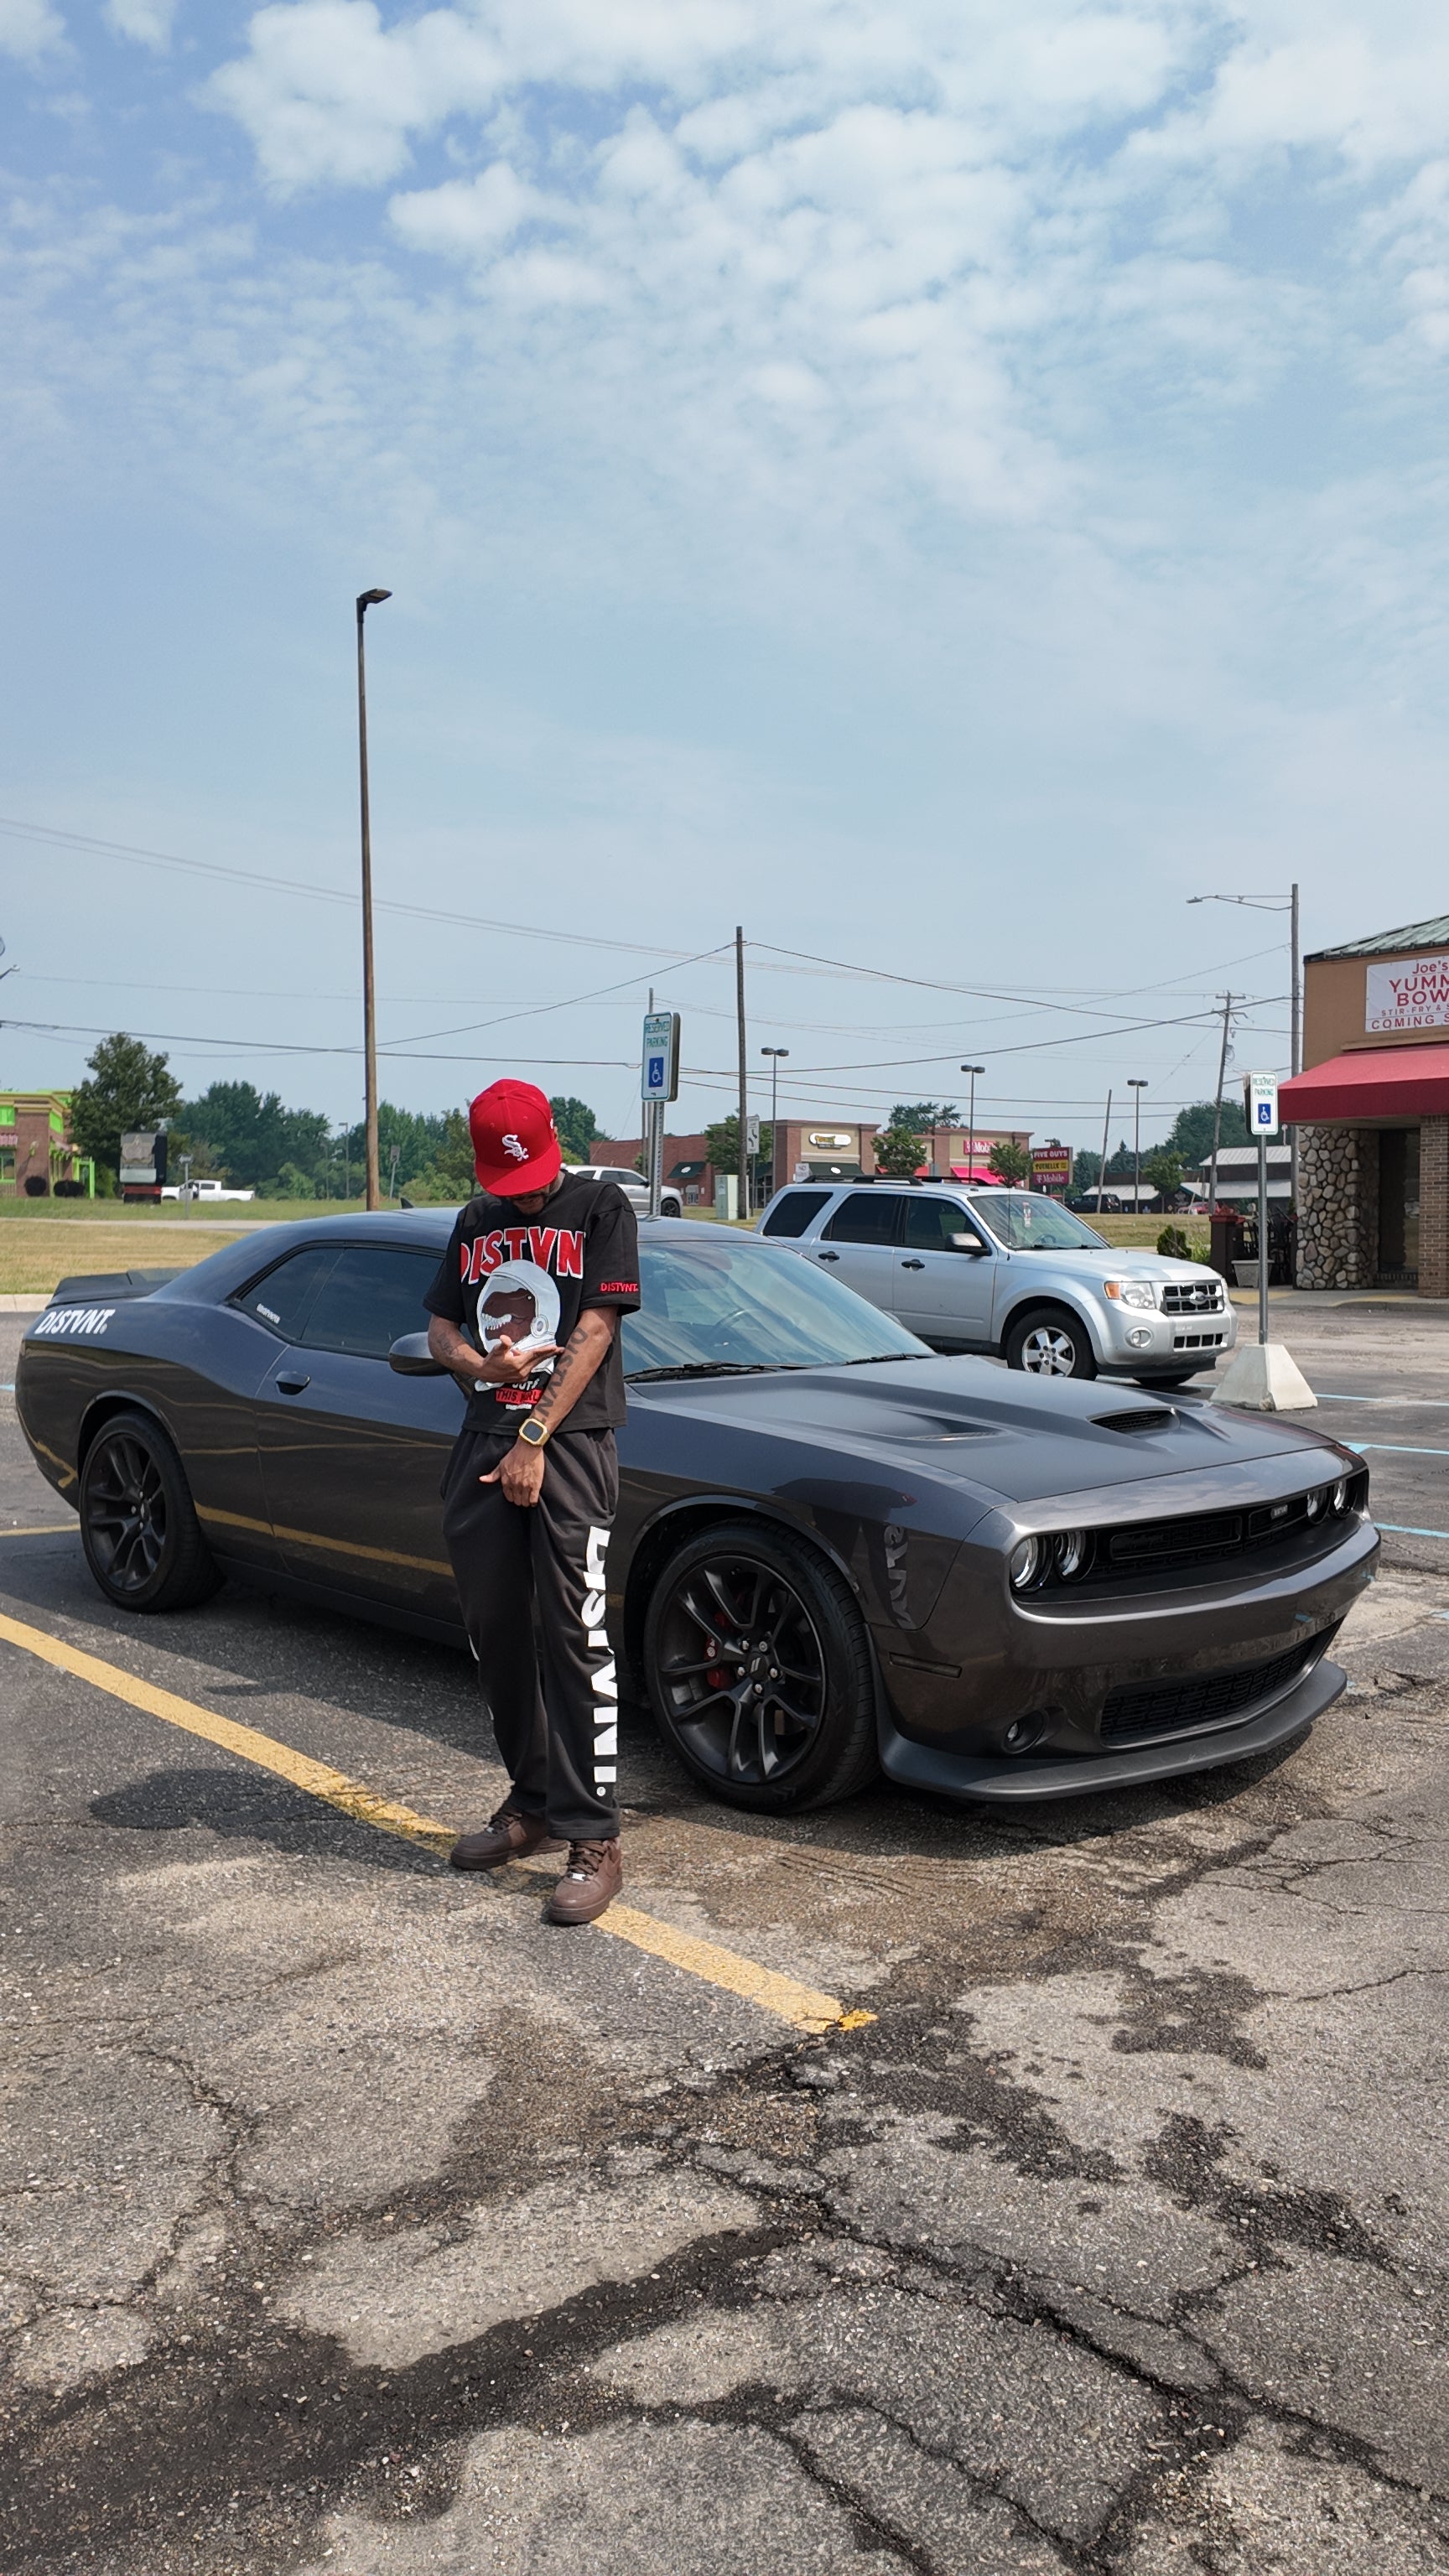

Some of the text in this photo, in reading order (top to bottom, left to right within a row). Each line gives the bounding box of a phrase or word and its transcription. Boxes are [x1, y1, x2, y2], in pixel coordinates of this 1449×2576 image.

[1412, 960, 1448, 974] Joe's
[1371, 1015, 1435, 1030] COMING
[647, 1036, 668, 1047] PARKING
[459, 1226, 586, 1285] DISTVN
[535, 1327, 589, 1425] DISTVN
